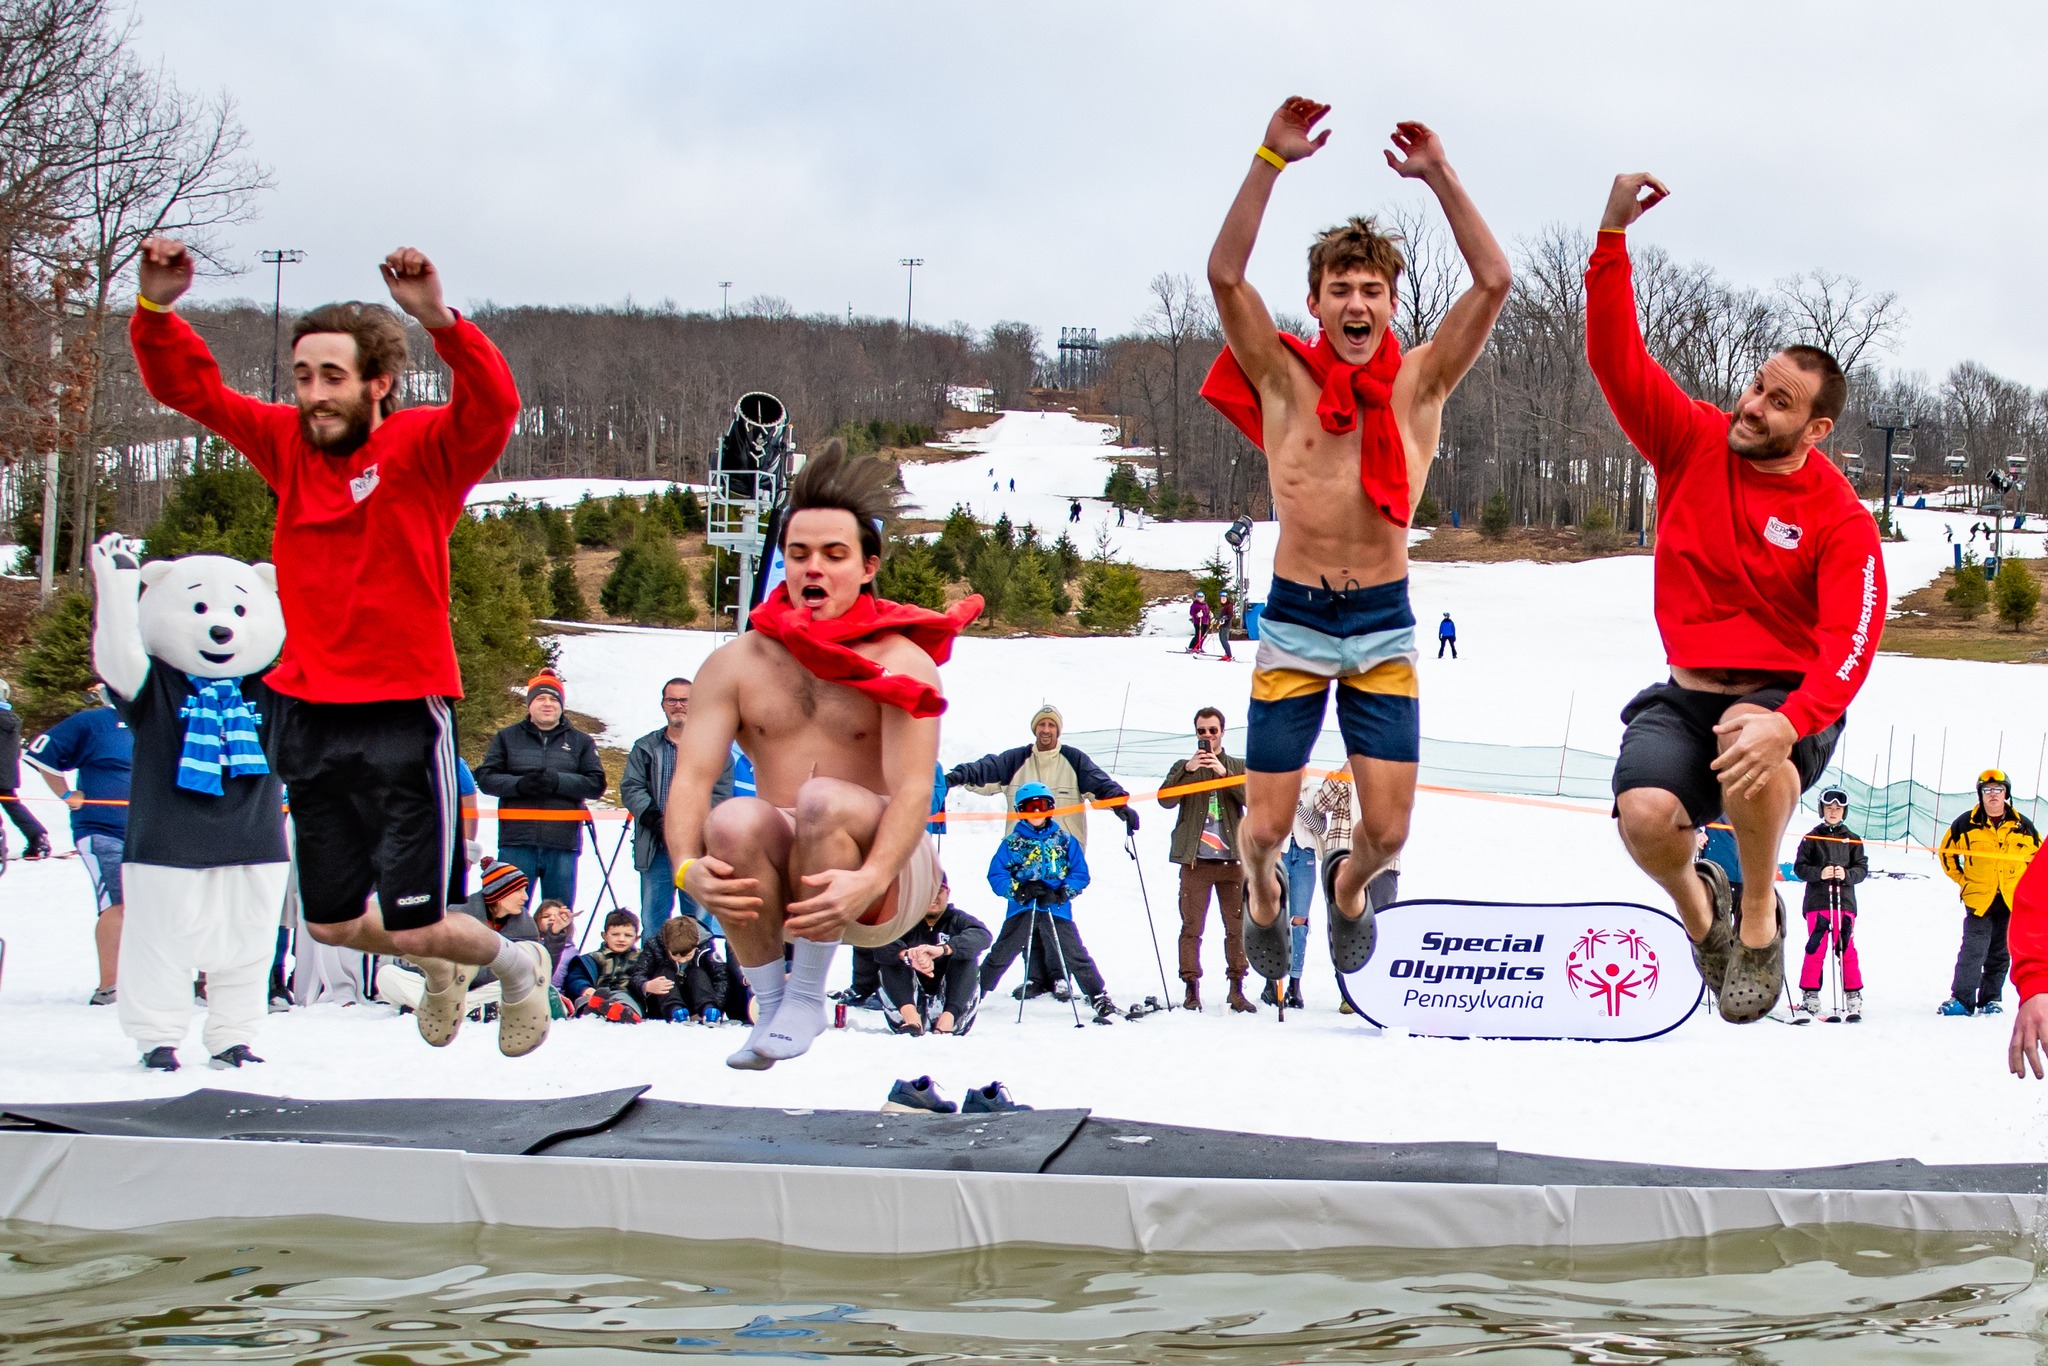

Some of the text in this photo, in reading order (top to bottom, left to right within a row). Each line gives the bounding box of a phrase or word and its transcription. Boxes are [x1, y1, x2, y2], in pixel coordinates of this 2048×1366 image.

[1421, 931, 1545, 956] Special
[1389, 959, 1545, 985] Olympics
[1404, 989, 1544, 1012] Pennsylvania
